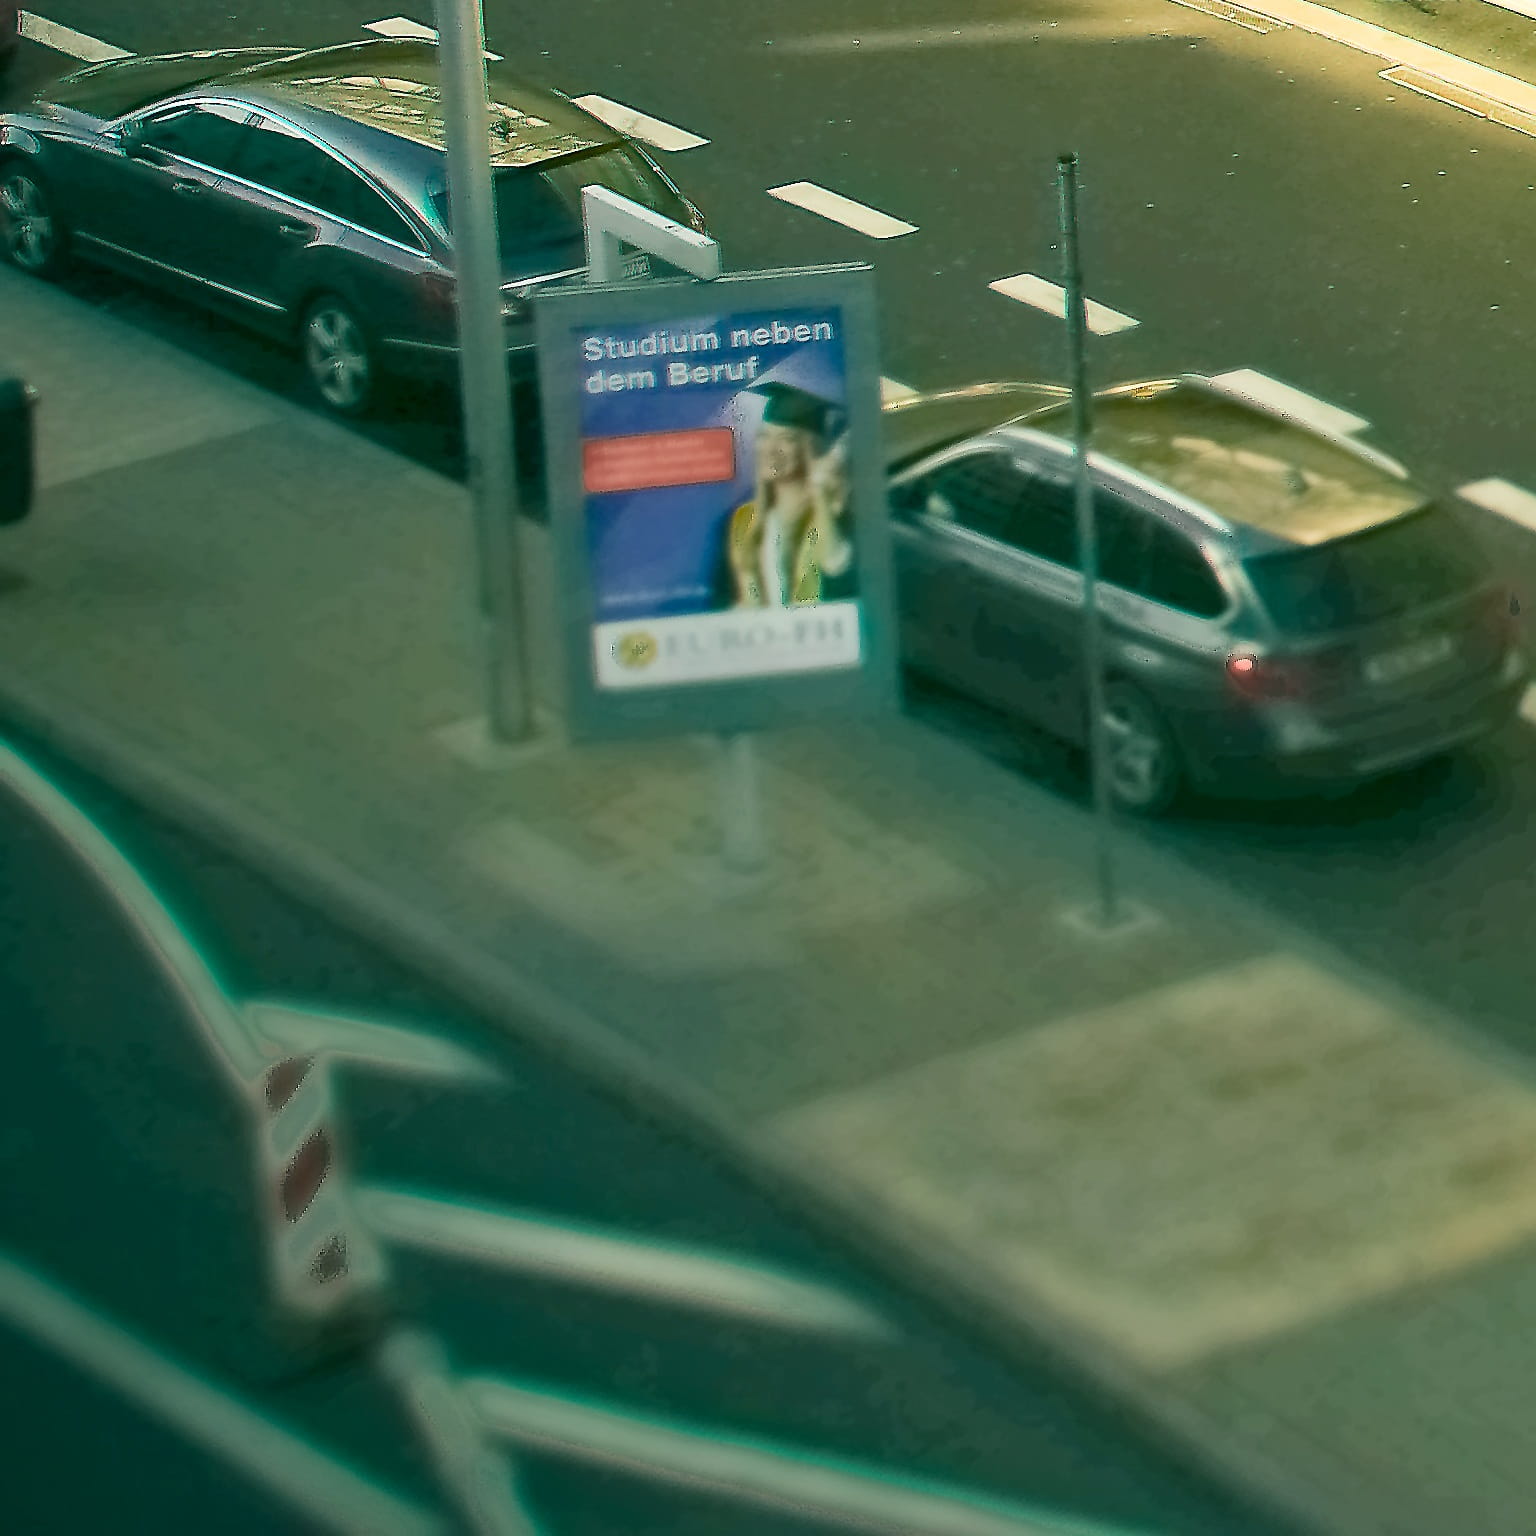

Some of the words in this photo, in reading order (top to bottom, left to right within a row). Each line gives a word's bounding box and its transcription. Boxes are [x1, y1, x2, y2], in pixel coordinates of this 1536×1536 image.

[583, 330, 720, 362] Studium
[730, 320, 833, 348] neben
[585, 370, 656, 395] dem
[667, 355, 760, 387] Beruf
